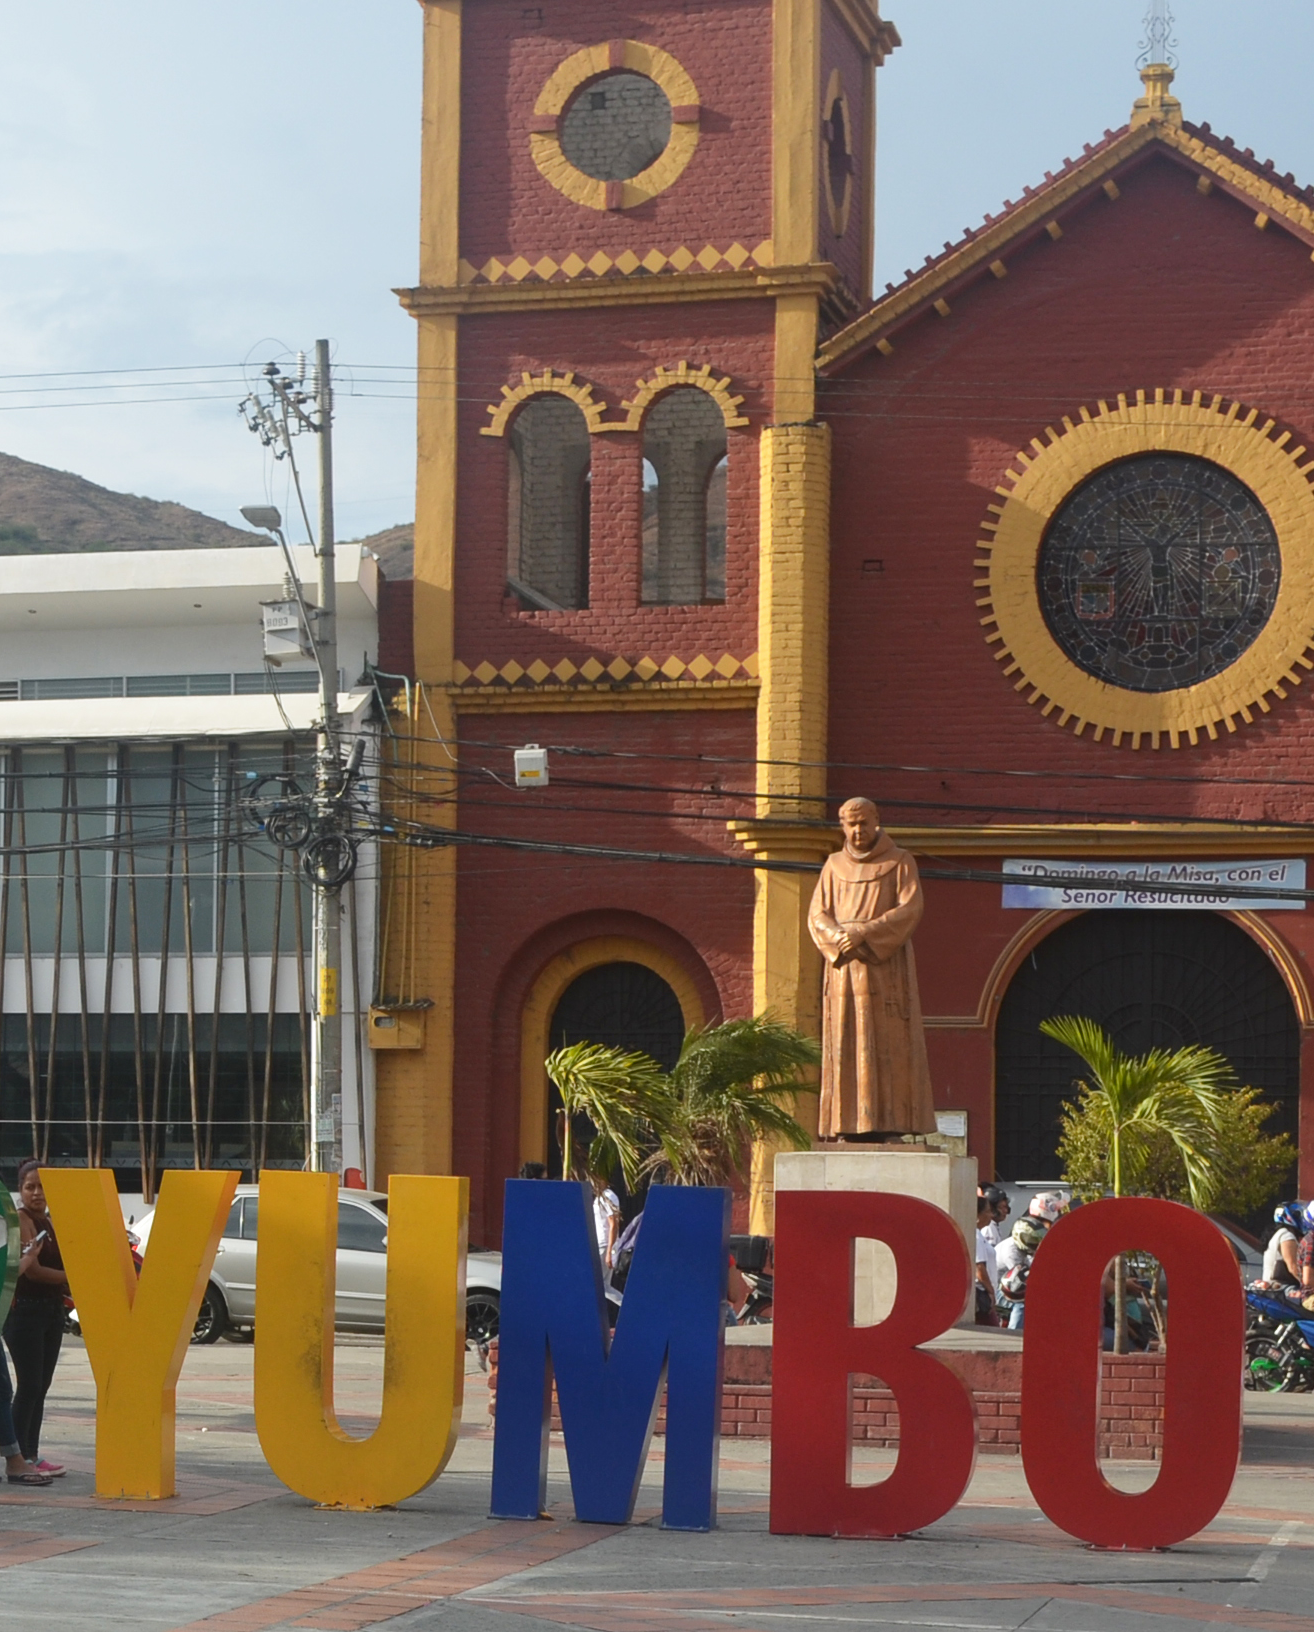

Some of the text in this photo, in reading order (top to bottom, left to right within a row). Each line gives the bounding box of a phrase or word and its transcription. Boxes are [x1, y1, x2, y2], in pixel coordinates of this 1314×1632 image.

[1126, 869, 1138, 881] a
[1144, 865, 1161, 881] la
[1166, 865, 1220, 883] Misa,
[1227, 869, 1262, 882] con
[1268, 865, 1287, 882] el
[39, 1168, 1246, 1552] YUMBO
